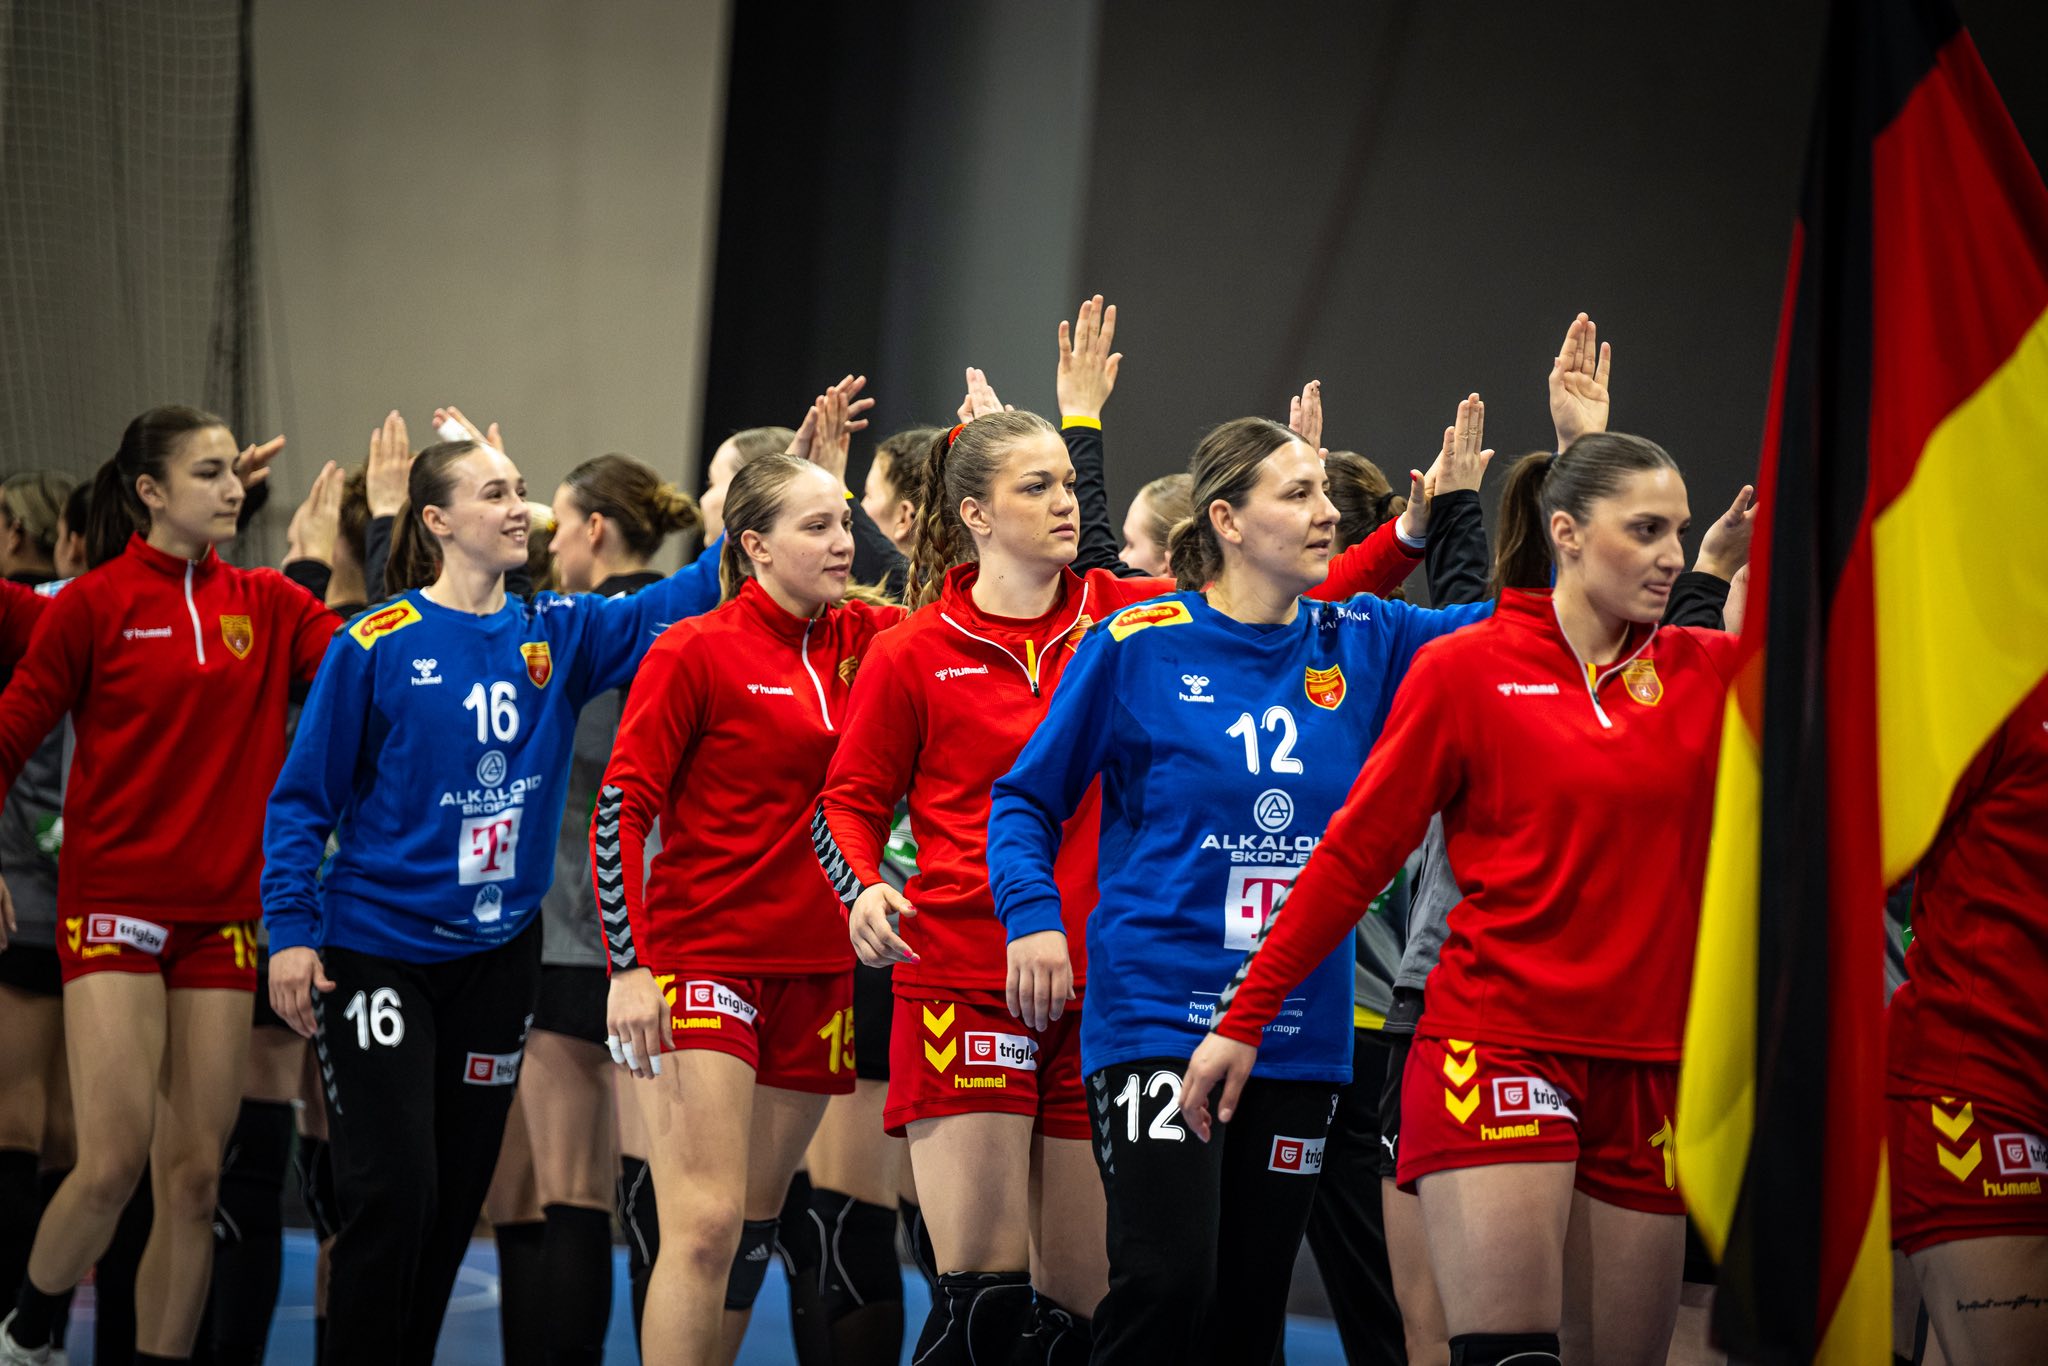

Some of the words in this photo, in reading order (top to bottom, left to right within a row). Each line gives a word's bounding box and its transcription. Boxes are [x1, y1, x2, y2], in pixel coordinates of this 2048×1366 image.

[1121, 607, 1174, 624] Maggi
[134, 626, 172, 638] hummel
[949, 664, 989, 678] hummel
[760, 684, 794, 696] hummel
[1179, 692, 1215, 703] hummel
[1514, 683, 1560, 695] hummel
[463, 680, 520, 744] 16
[1226, 705, 1303, 775] 12
[439, 774, 542, 807] ALKALOID
[462, 792, 525, 815] SKOPJE
[1200, 834, 1321, 851] ALKALOI
[1230, 851, 1310, 863] SKOPJE
[120, 922, 161, 947] triglav
[1189, 1001, 1215, 1011] Репуб
[343, 987, 405, 1050] 16
[672, 1016, 721, 1029] hummel
[1273, 1024, 1301, 1035] спорт
[1000, 1042, 1034, 1064] trigl
[954, 1073, 1006, 1088] hummel
[1114, 1070, 1186, 1143] 12
[1481, 1119, 1540, 1141] hummel
[1305, 1147, 1323, 1167] trig
[1983, 1176, 2041, 1197] hummel
